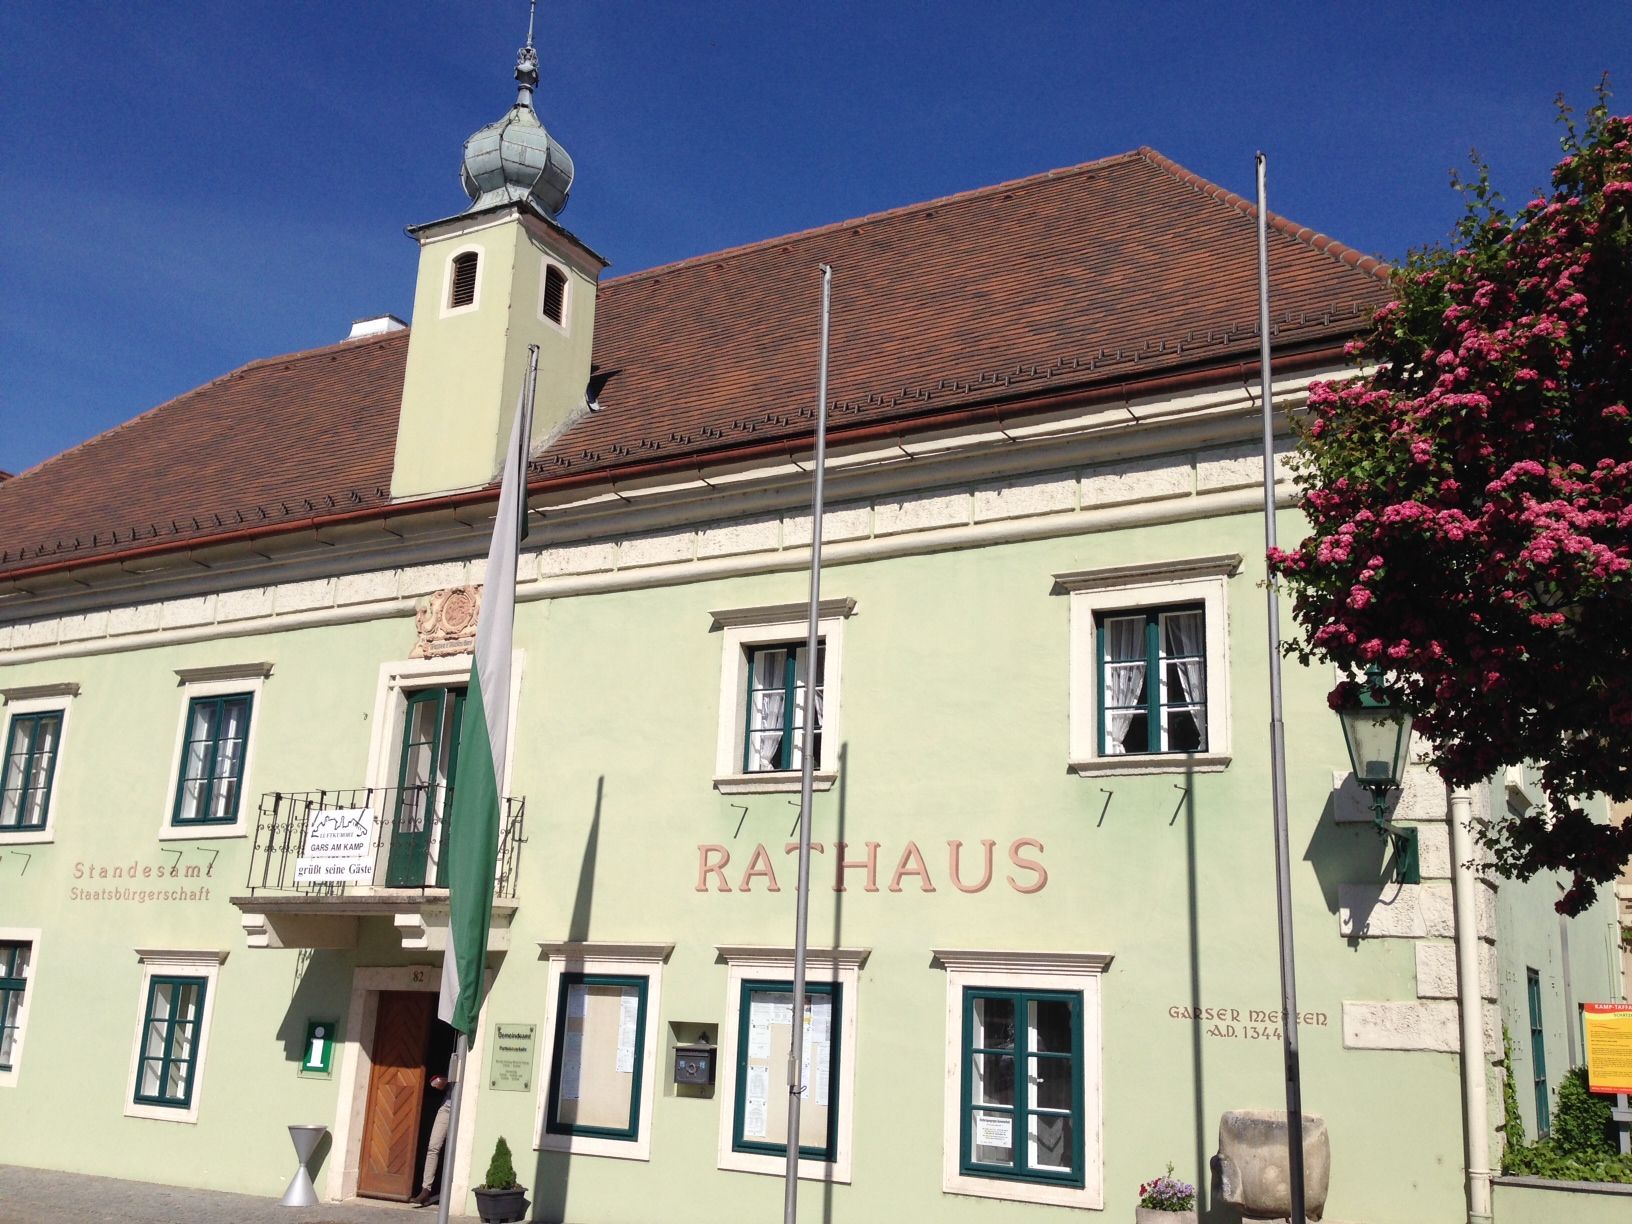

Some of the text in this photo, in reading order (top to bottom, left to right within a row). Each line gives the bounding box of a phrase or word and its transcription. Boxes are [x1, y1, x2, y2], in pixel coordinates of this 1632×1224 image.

[310, 842, 364, 852] GARS AM KAMP
[73, 861, 213, 879] Standesamt
[298, 863, 372, 876] grüßt seine Gäste
[695, 837, 1048, 894] RATHAUS
[70, 886, 211, 903] Staatsbürgerschaft
[413, 970, 424, 983] 82
[1168, 1006, 1241, 1022] GARSER
[1206, 1025, 1282, 1040] A.D. 1344
